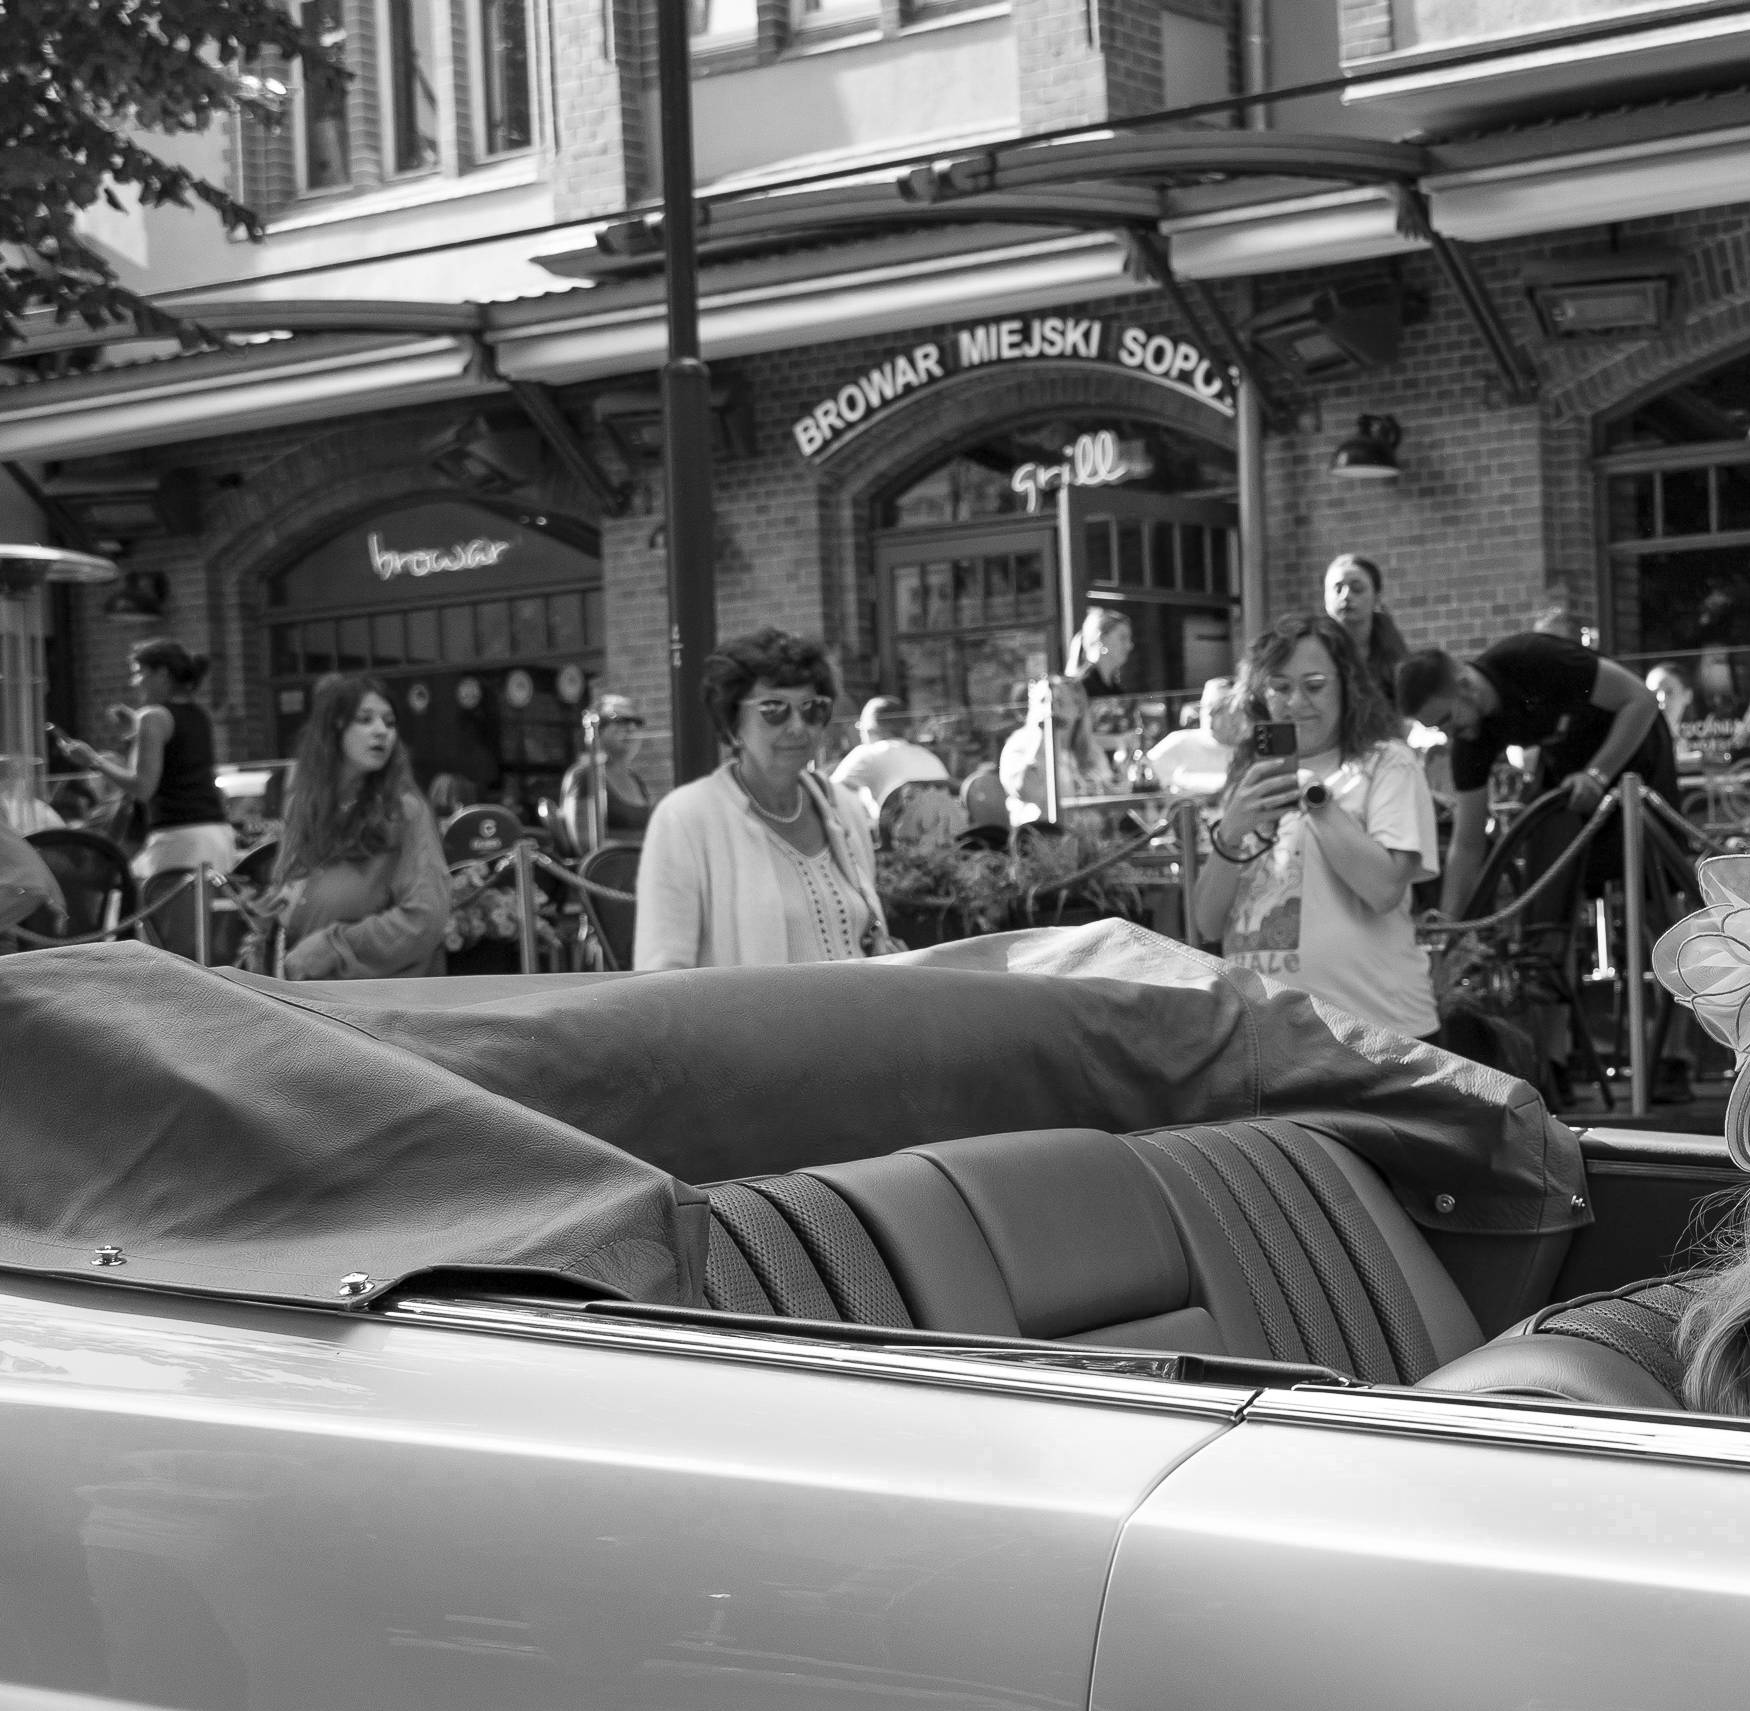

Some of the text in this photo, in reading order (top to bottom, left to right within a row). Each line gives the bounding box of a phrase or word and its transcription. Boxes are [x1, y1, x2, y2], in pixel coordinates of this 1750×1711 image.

[792, 317, 1240, 456] BROWAR MIEJSKI SOPO
[1010, 429, 1129, 514] grill
[367, 530, 510, 581] browar
